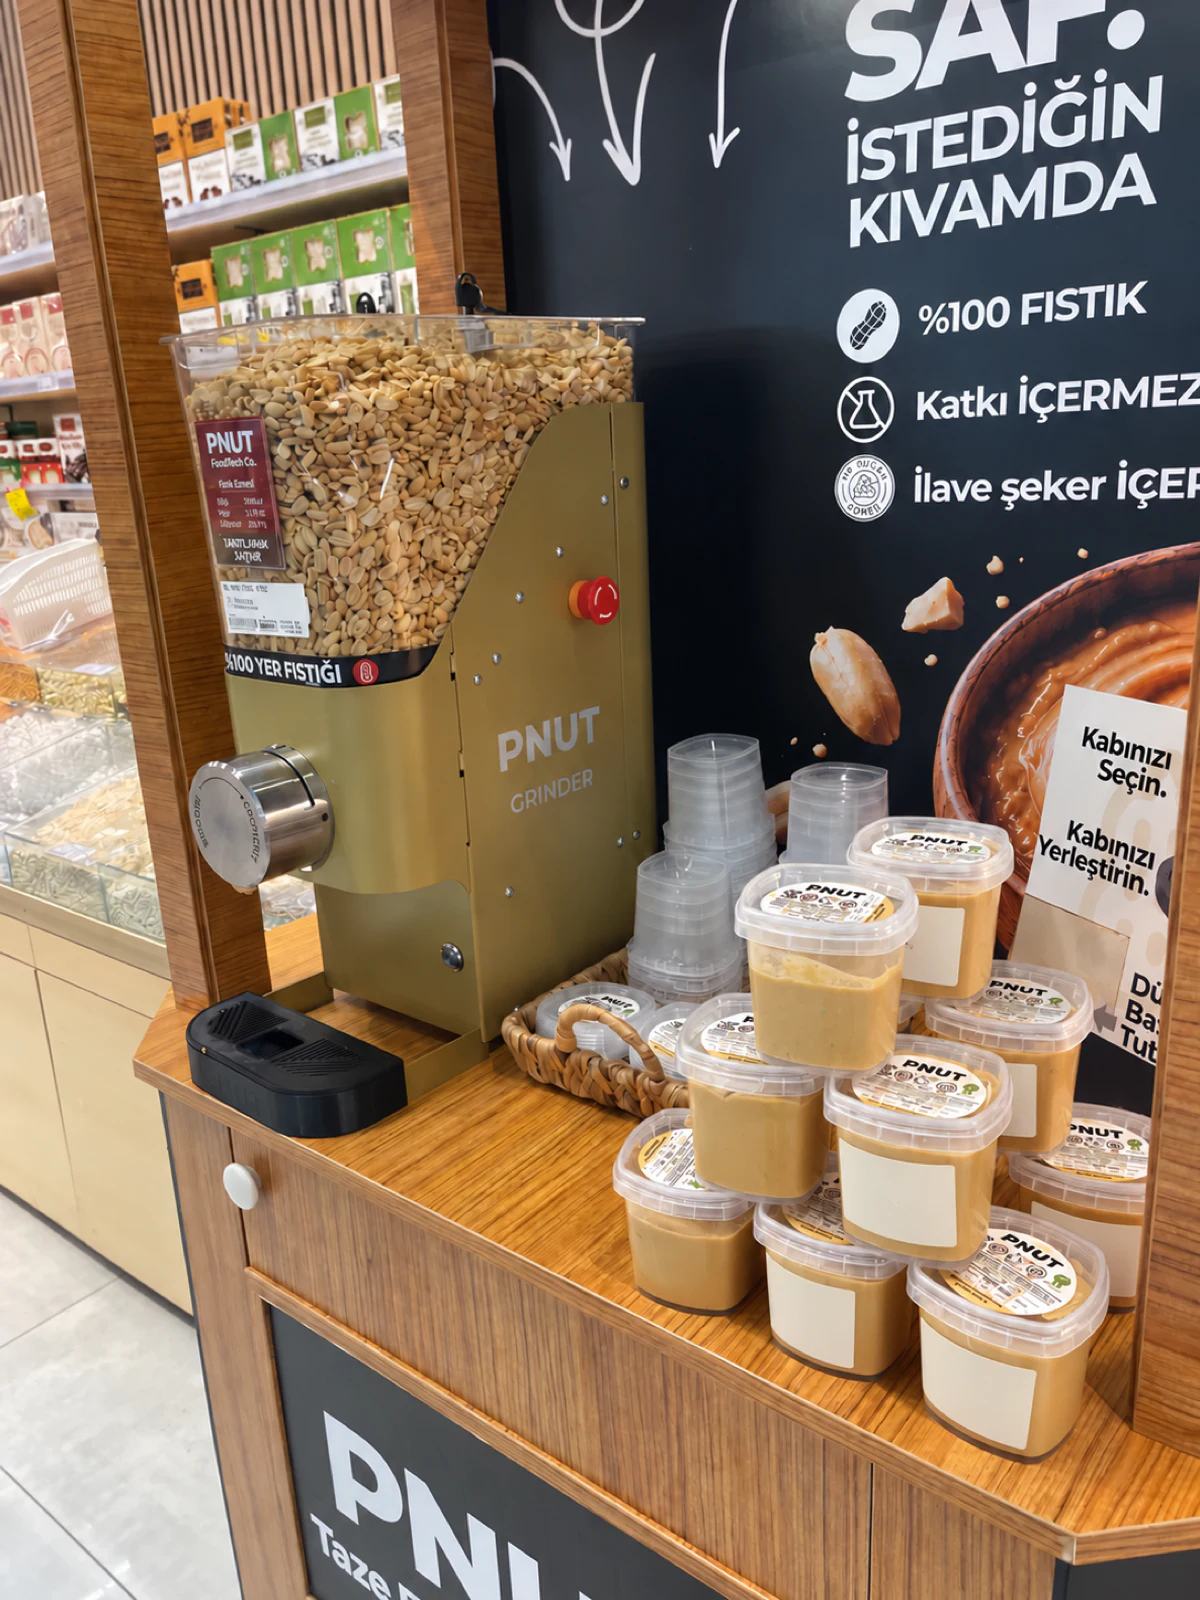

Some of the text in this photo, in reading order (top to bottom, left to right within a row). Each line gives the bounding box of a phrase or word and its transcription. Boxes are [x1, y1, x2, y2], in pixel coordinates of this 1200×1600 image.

[847, 68, 1164, 185] İSTEDİĞİN
[849, 152, 1157, 248] KIVAMDA
[918, 280, 1148, 336] %100 FISTIK
[916, 372, 1200, 423] Katkı İÇERMEZ
[205, 430, 254, 454] PNUT
[914, 466, 993, 503] İlave
[1000, 474, 1107, 511] şeker
[254, 657, 282, 678] YER
[284, 659, 342, 684] FISTIĞI
[497, 705, 600, 773] PNUT
[1081, 726, 1172, 771] Kabınızı
[510, 768, 593, 813] GRINDER
[1097, 758, 1167, 798] Seçin.
[910, 834, 968, 846] PNUT
[1066, 820, 1156, 870] Kabınızı
[1038, 834, 1149, 896] Yerleştirin.
[805, 884, 866, 899] PNUT
[989, 980, 1048, 996] PNUT
[902, 1059, 967, 1081] PNUT
[1000, 1233, 1064, 1269] PNUT
[310, 1513, 392, 1600] Taze
